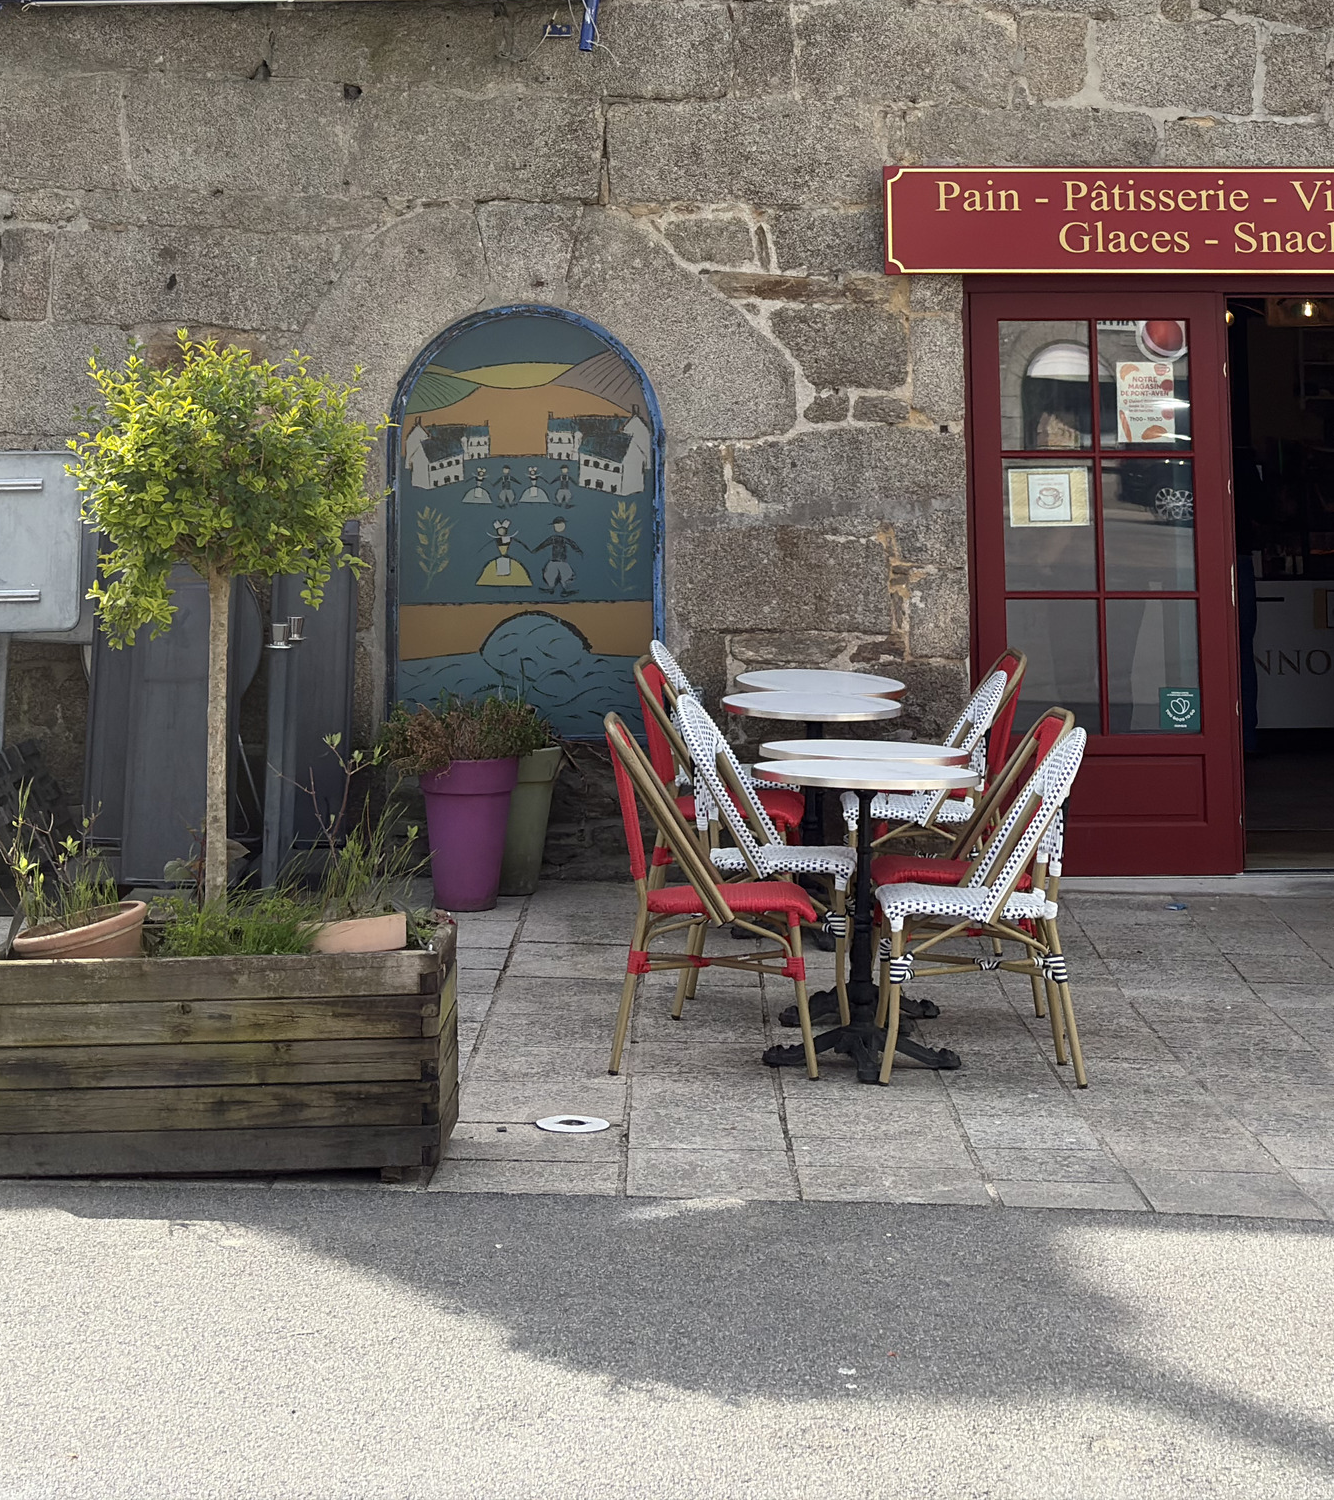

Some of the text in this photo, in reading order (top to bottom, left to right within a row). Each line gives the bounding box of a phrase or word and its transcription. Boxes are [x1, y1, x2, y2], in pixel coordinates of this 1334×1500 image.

[935, 180, 1022, 214] Pain
[1062, 179, 1250, 215] Pâtisserie
[1058, 220, 1191, 255] Glaces
